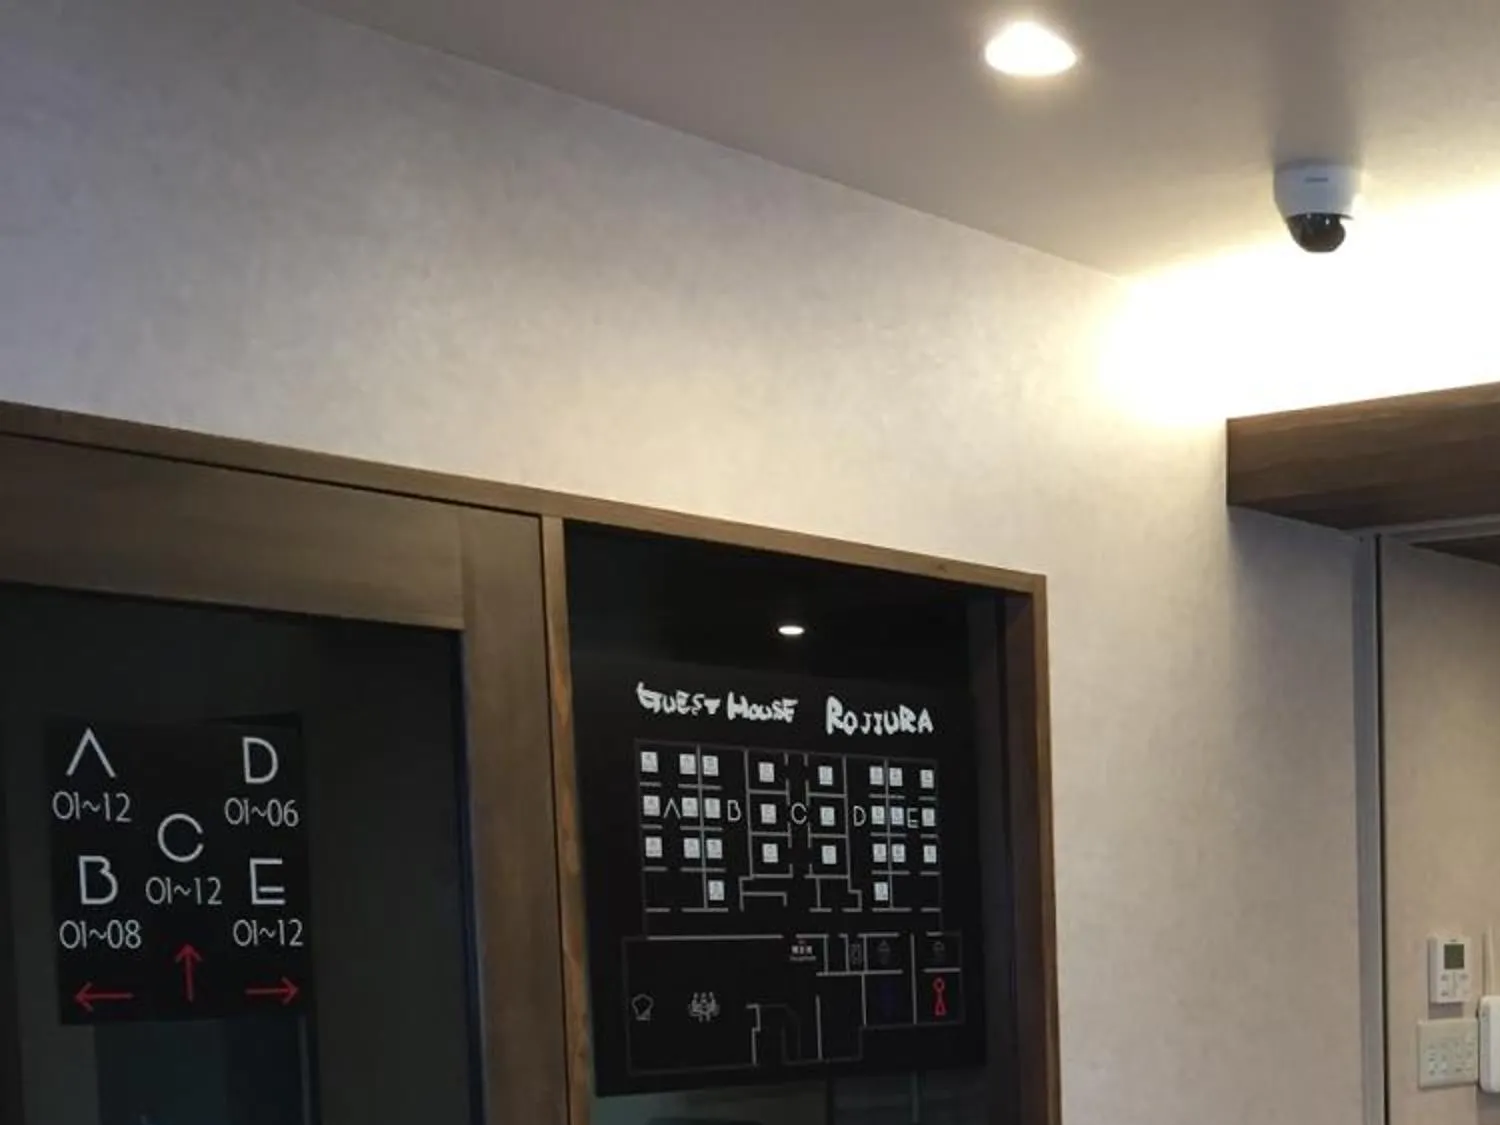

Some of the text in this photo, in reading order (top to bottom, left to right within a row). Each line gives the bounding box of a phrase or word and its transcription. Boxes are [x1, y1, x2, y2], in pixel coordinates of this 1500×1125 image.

[727, 690, 798, 723] HOUSE
[826, 695, 934, 736] ROJIURA
[66, 727, 116, 778] A
[242, 736, 279, 784] D
[727, 799, 741, 822] B
[791, 803, 808, 825] C
[853, 805, 866, 827] D
[907, 807, 919, 829] E
[157, 813, 204, 863] C
[78, 855, 118, 905] B
[249, 858, 286, 905] E
